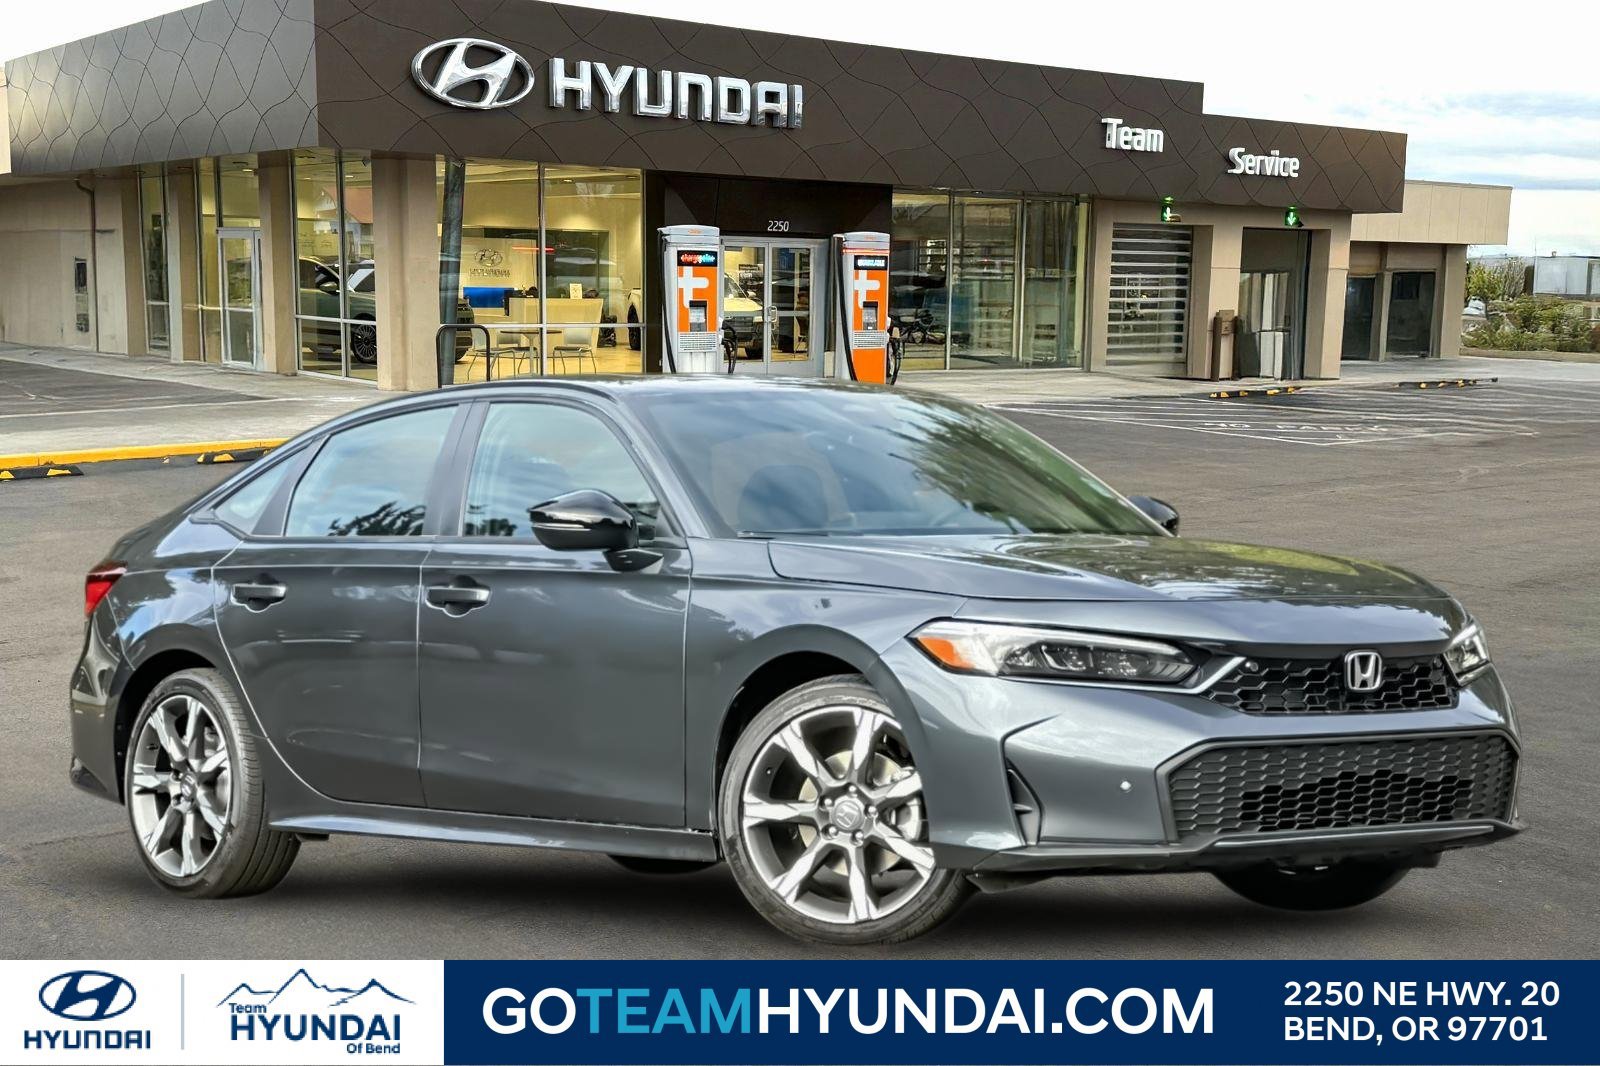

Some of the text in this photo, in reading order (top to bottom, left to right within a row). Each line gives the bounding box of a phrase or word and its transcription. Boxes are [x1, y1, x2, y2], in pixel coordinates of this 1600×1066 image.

[549, 57, 803, 129] HYUNDAI
[1101, 117, 1164, 153] Team
[1227, 147, 1300, 178] Service
[767, 220, 790, 232] 2250
